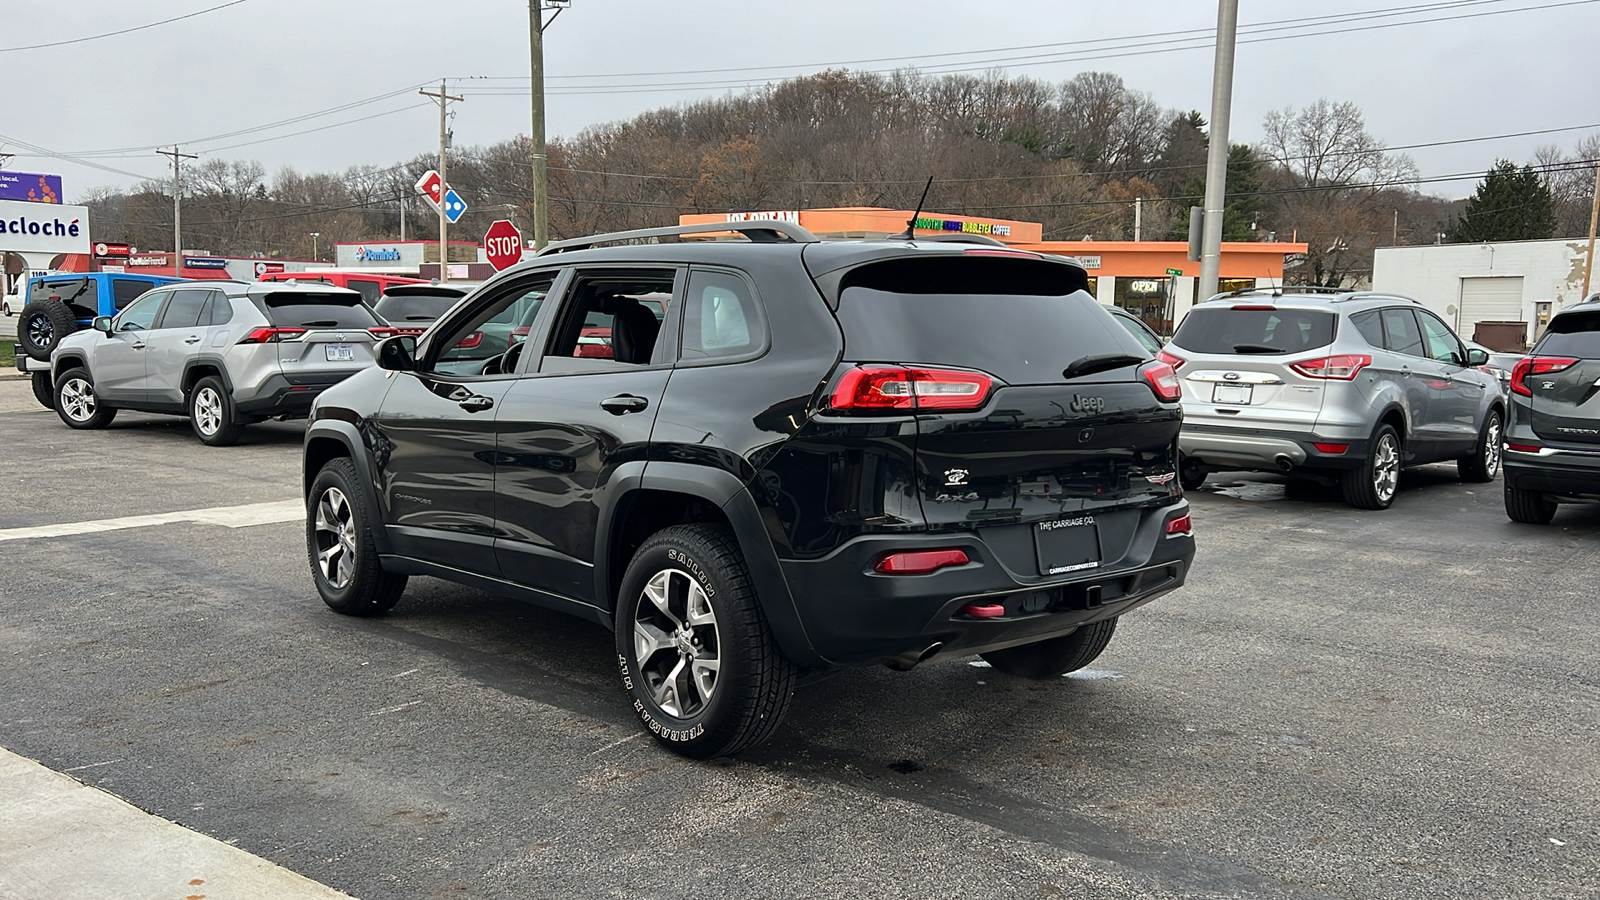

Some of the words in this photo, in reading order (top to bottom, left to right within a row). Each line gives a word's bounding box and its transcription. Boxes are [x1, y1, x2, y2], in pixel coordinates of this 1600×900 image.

[992, 224, 1011, 236] COFFEE
[364, 248, 400, 261] Domino's
[488, 236, 519, 257] STOP
[1131, 280, 1158, 292] OPEN
[1070, 393, 1105, 414] Jeep
[1039, 522, 1052, 531] THE
[1052, 517, 1083, 529] CARRIAGE
[1084, 516, 1095, 525] CO.
[668, 549, 716, 597] SAILUN
[633, 698, 705, 742] TERRAMAX
